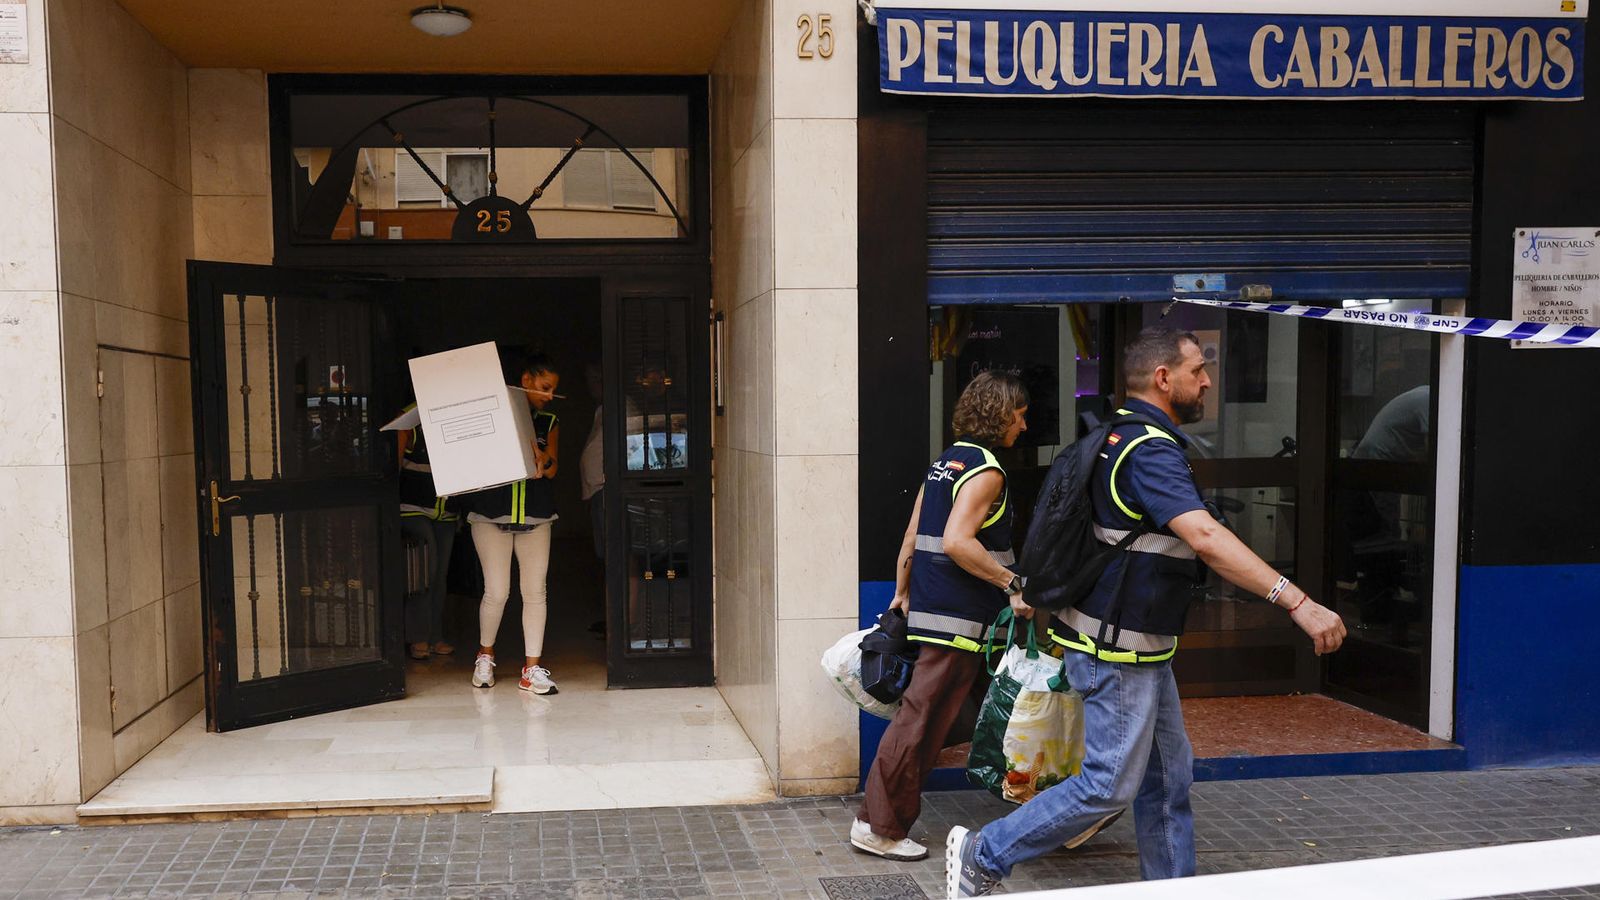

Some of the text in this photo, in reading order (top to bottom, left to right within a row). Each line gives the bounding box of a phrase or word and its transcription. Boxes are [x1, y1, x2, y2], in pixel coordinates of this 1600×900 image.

[797, 13, 834, 59] 25
[886, 18, 1575, 91] PELUQUERIA CABALLEROS
[476, 209, 512, 233] 25
[1537, 240, 1596, 250] JUAN CARLOS
[1563, 283, 1583, 292] NIÑOS
[1343, 309, 1459, 328] CNP NO PASAR
